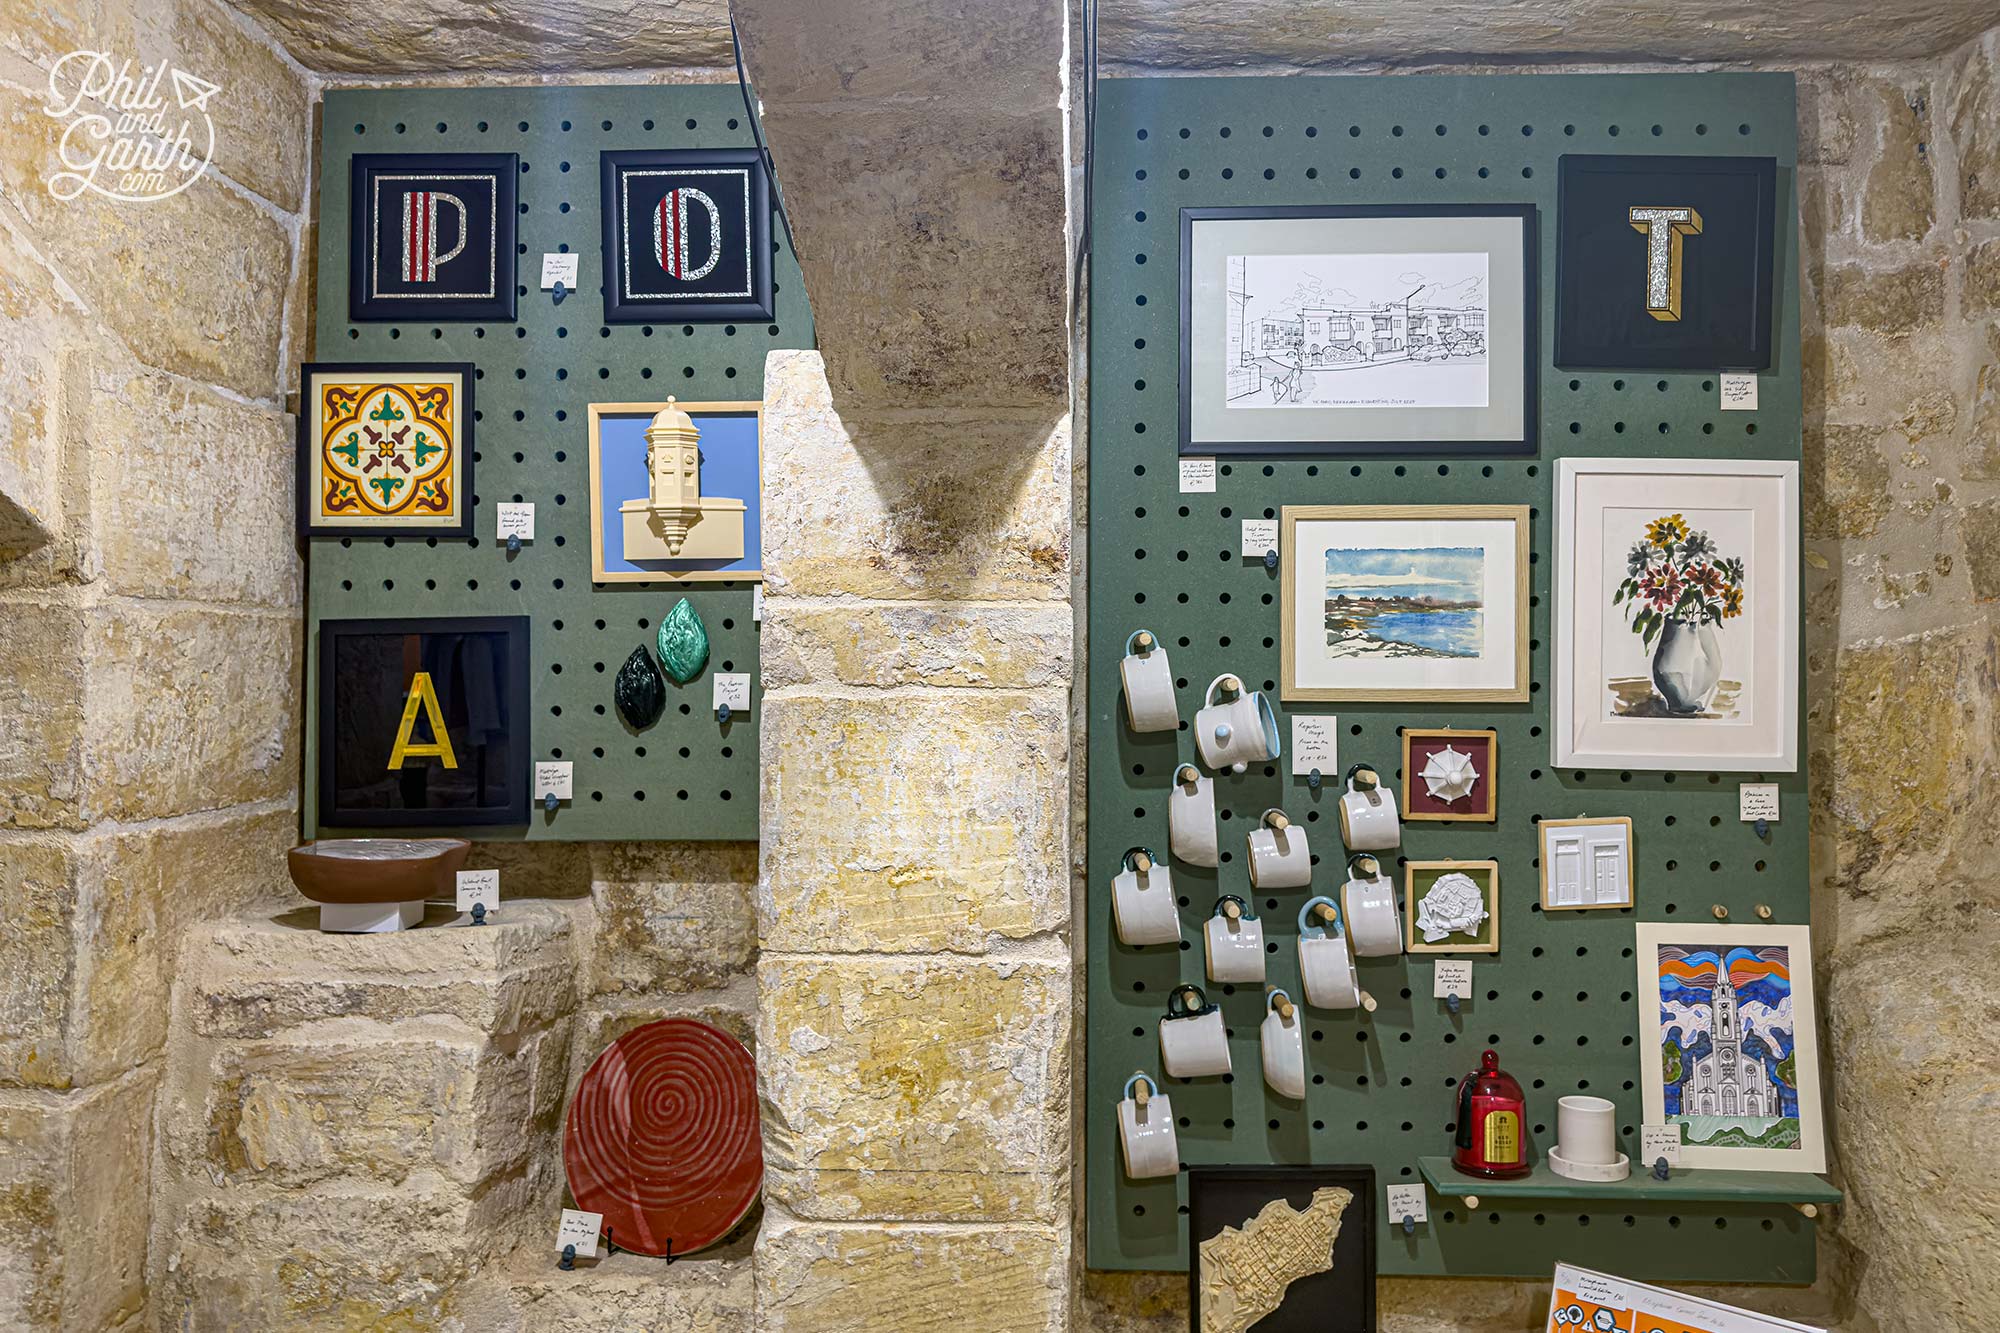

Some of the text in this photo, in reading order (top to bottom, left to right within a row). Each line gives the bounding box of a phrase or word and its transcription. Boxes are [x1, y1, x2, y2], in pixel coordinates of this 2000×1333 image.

[402, 191, 467, 283] P
[1629, 206, 1703, 322] T
[387, 671, 459, 770] A
